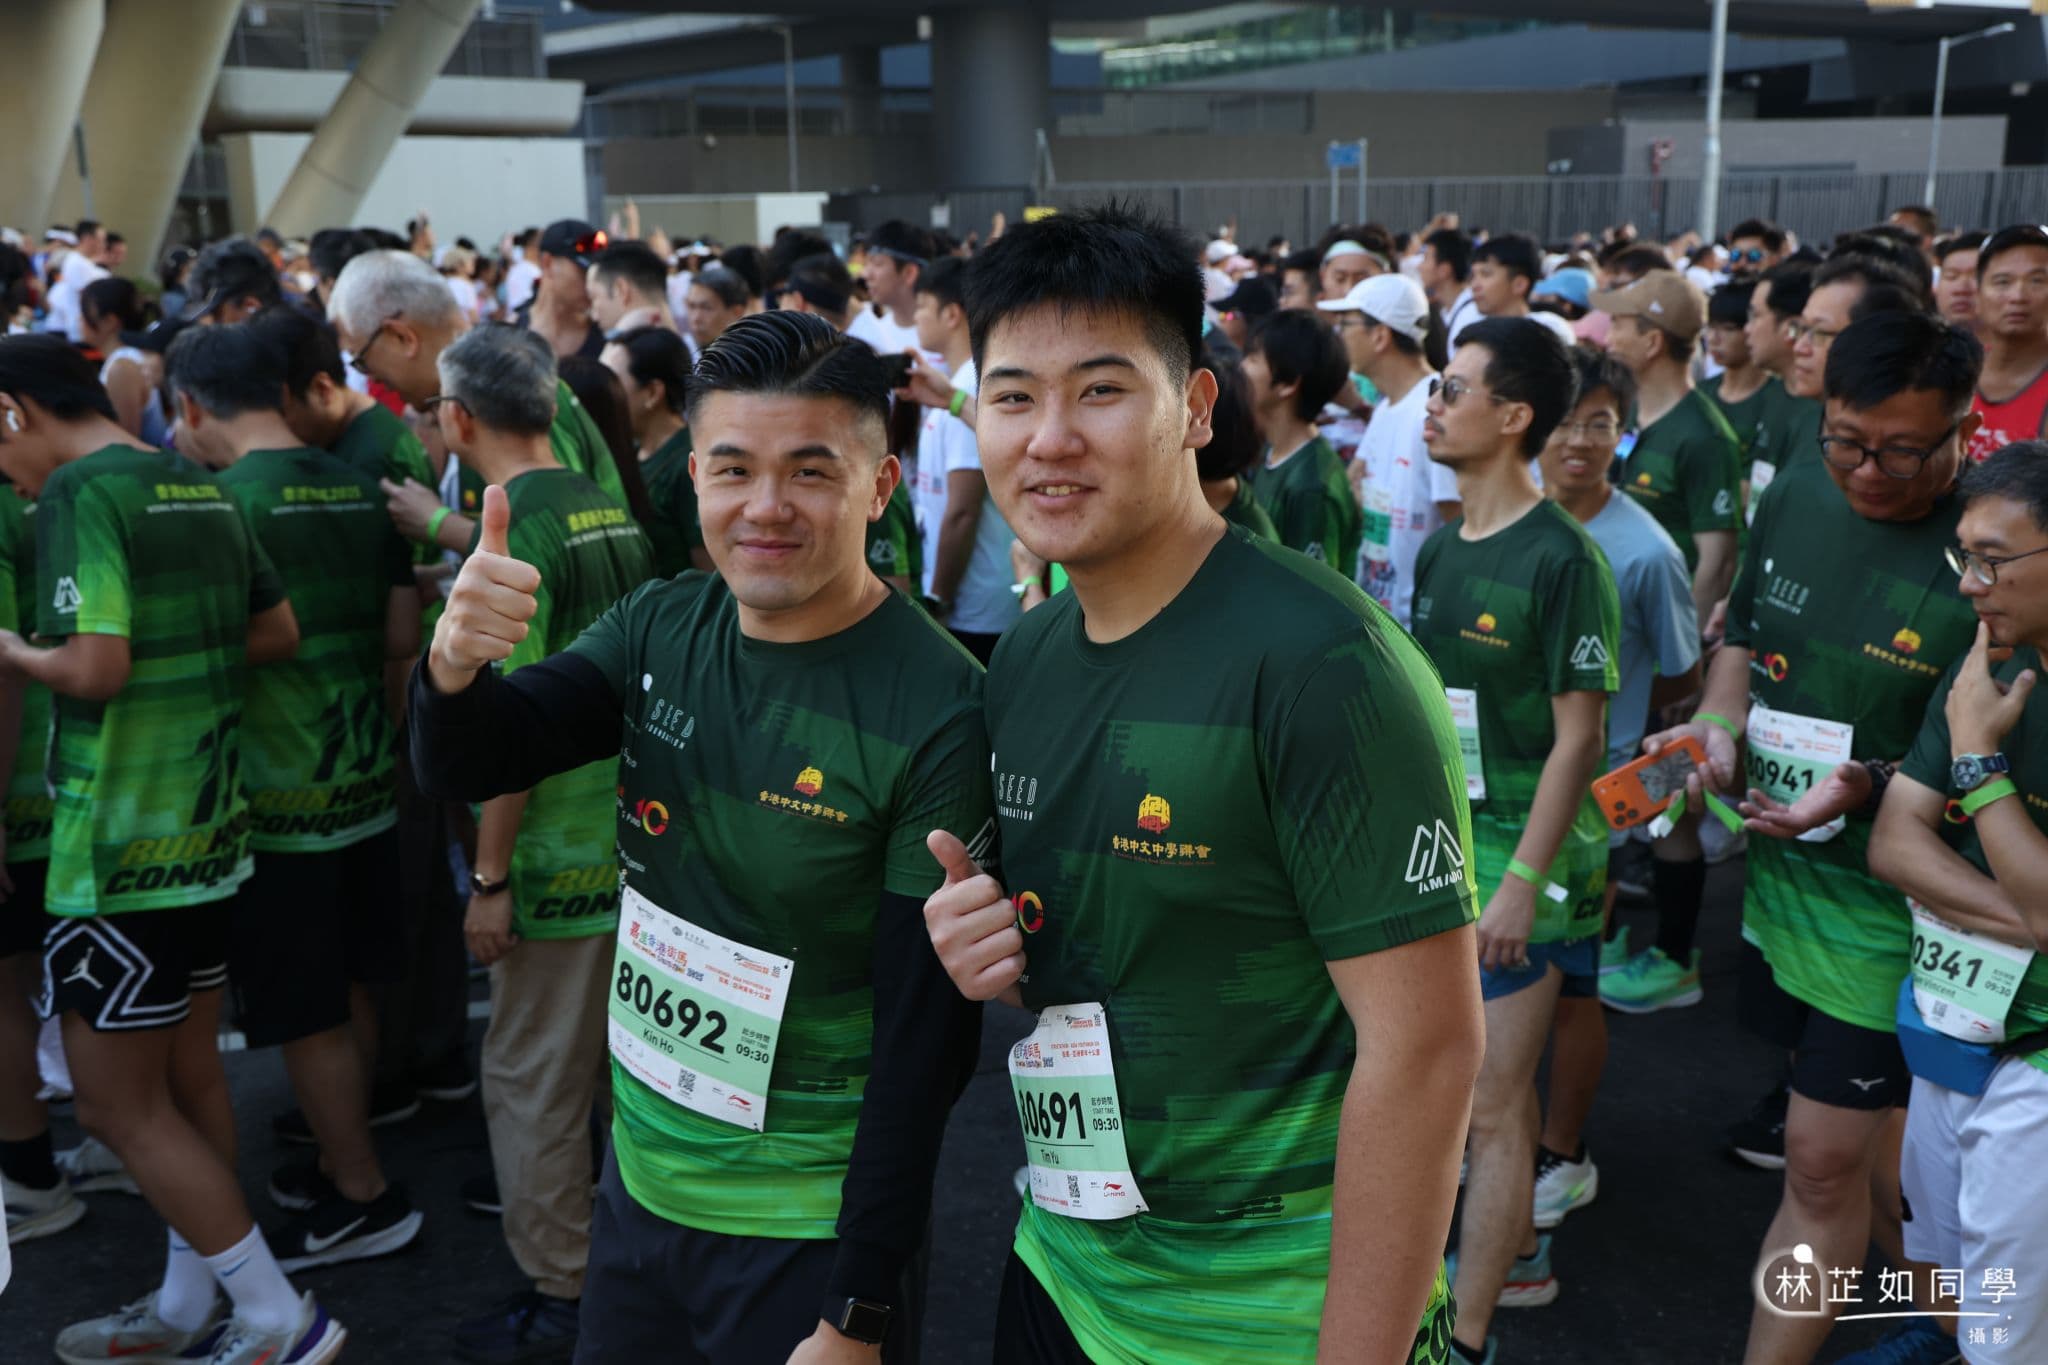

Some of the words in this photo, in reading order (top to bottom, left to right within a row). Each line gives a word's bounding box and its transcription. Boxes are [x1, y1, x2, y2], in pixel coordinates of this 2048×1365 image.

[616, 961, 728, 1055] 80692
[642, 1028, 659, 1047] Kin
[659, 1038, 675, 1055] Ho
[735, 1043, 770, 1065] 09:30
[1092, 1117, 1119, 1131] 09:30
